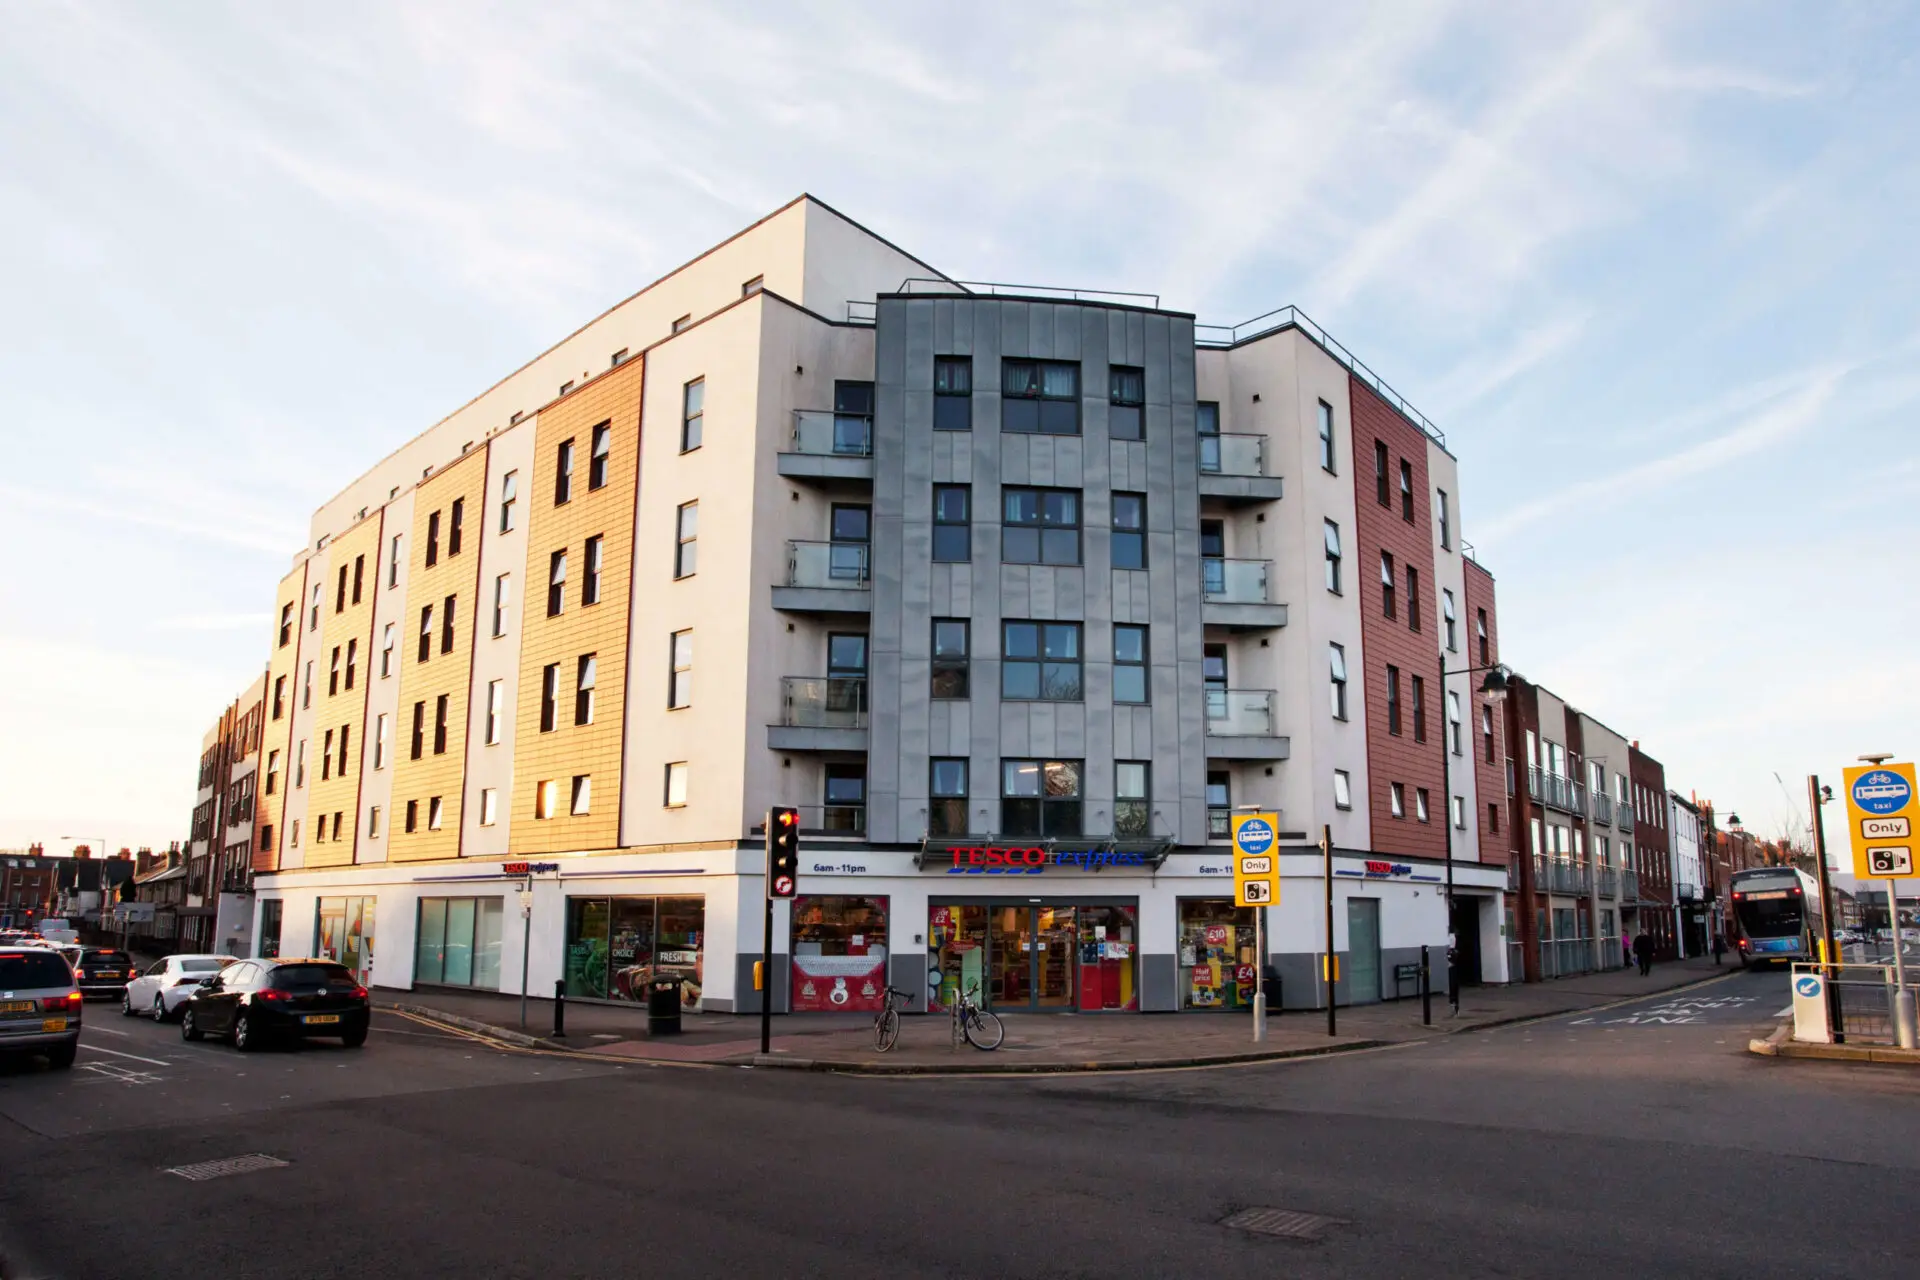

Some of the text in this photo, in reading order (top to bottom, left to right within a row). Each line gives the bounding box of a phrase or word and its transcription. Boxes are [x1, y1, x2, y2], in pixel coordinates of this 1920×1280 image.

[1873, 801, 1892, 809] taxi
[1869, 823, 1902, 833] Only
[946, 847, 1145, 872] TESCO express
[813, 863, 834, 872] 6am
[841, 863, 867, 874] 11pm
[1199, 865, 1219, 874] 6am
[1245, 861, 1267, 870] Only
[1209, 929, 1226, 938] £10
[612, 949, 635, 958] CHOICE
[660, 952, 682, 962] FRESH
[1195, 967, 1209, 975] Half
[1237, 967, 1254, 979] £4
